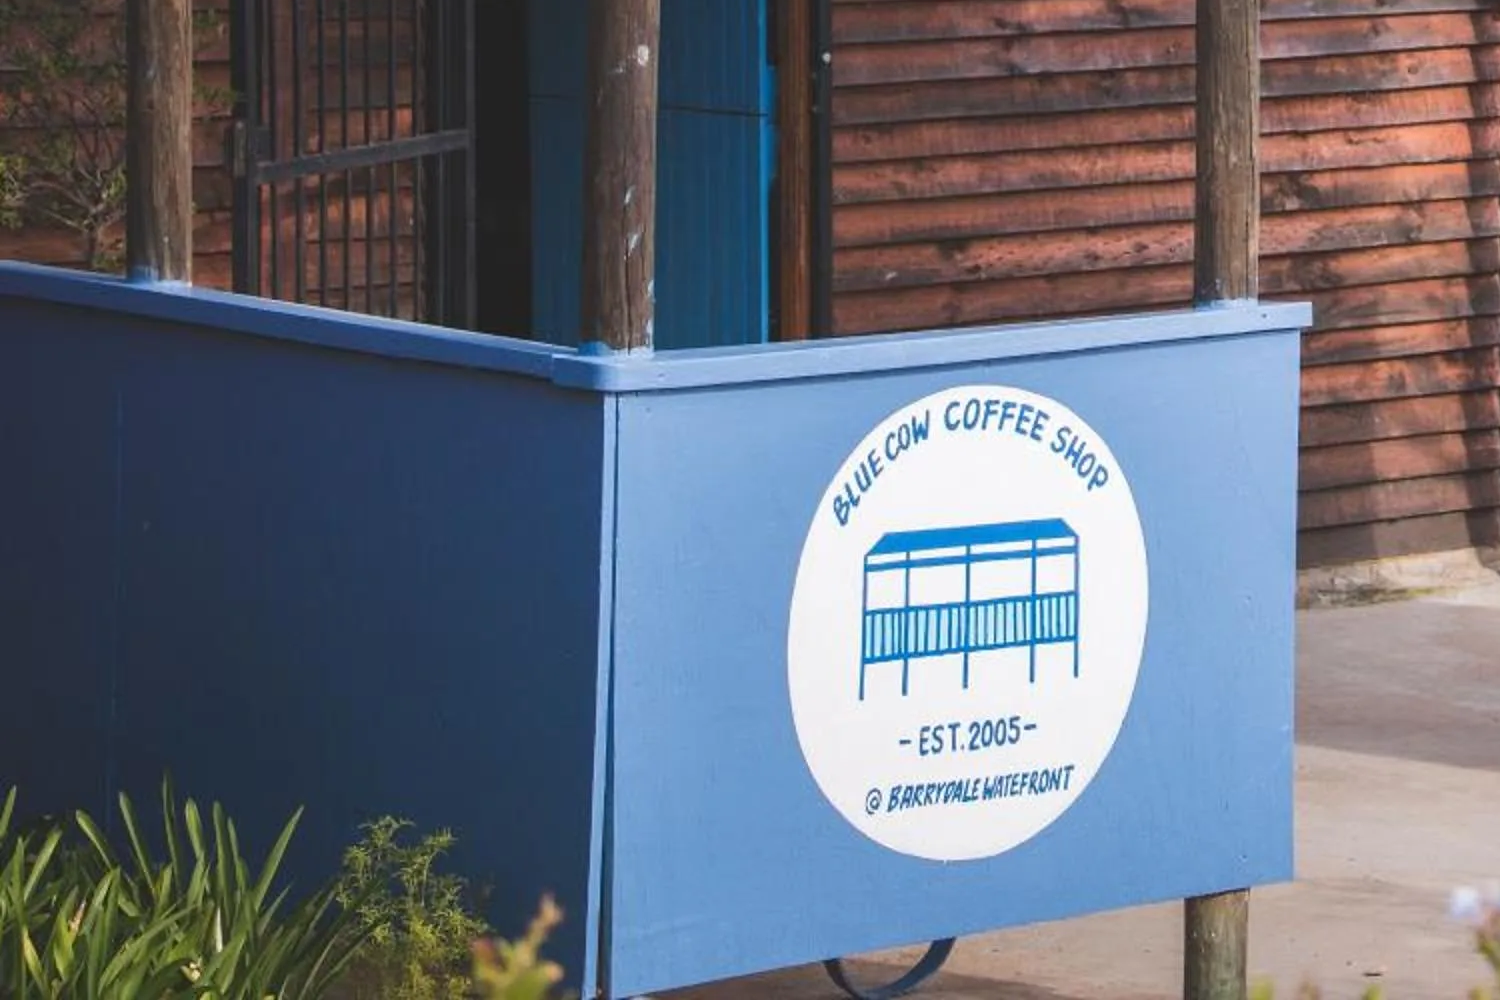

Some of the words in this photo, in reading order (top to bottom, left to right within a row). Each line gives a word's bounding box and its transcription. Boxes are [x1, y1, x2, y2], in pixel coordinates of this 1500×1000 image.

[833, 449, 884, 526] BLUE
[885, 410, 930, 460] COW
[944, 398, 1049, 441] COFFEE
[1050, 426, 1109, 491] SHOP
